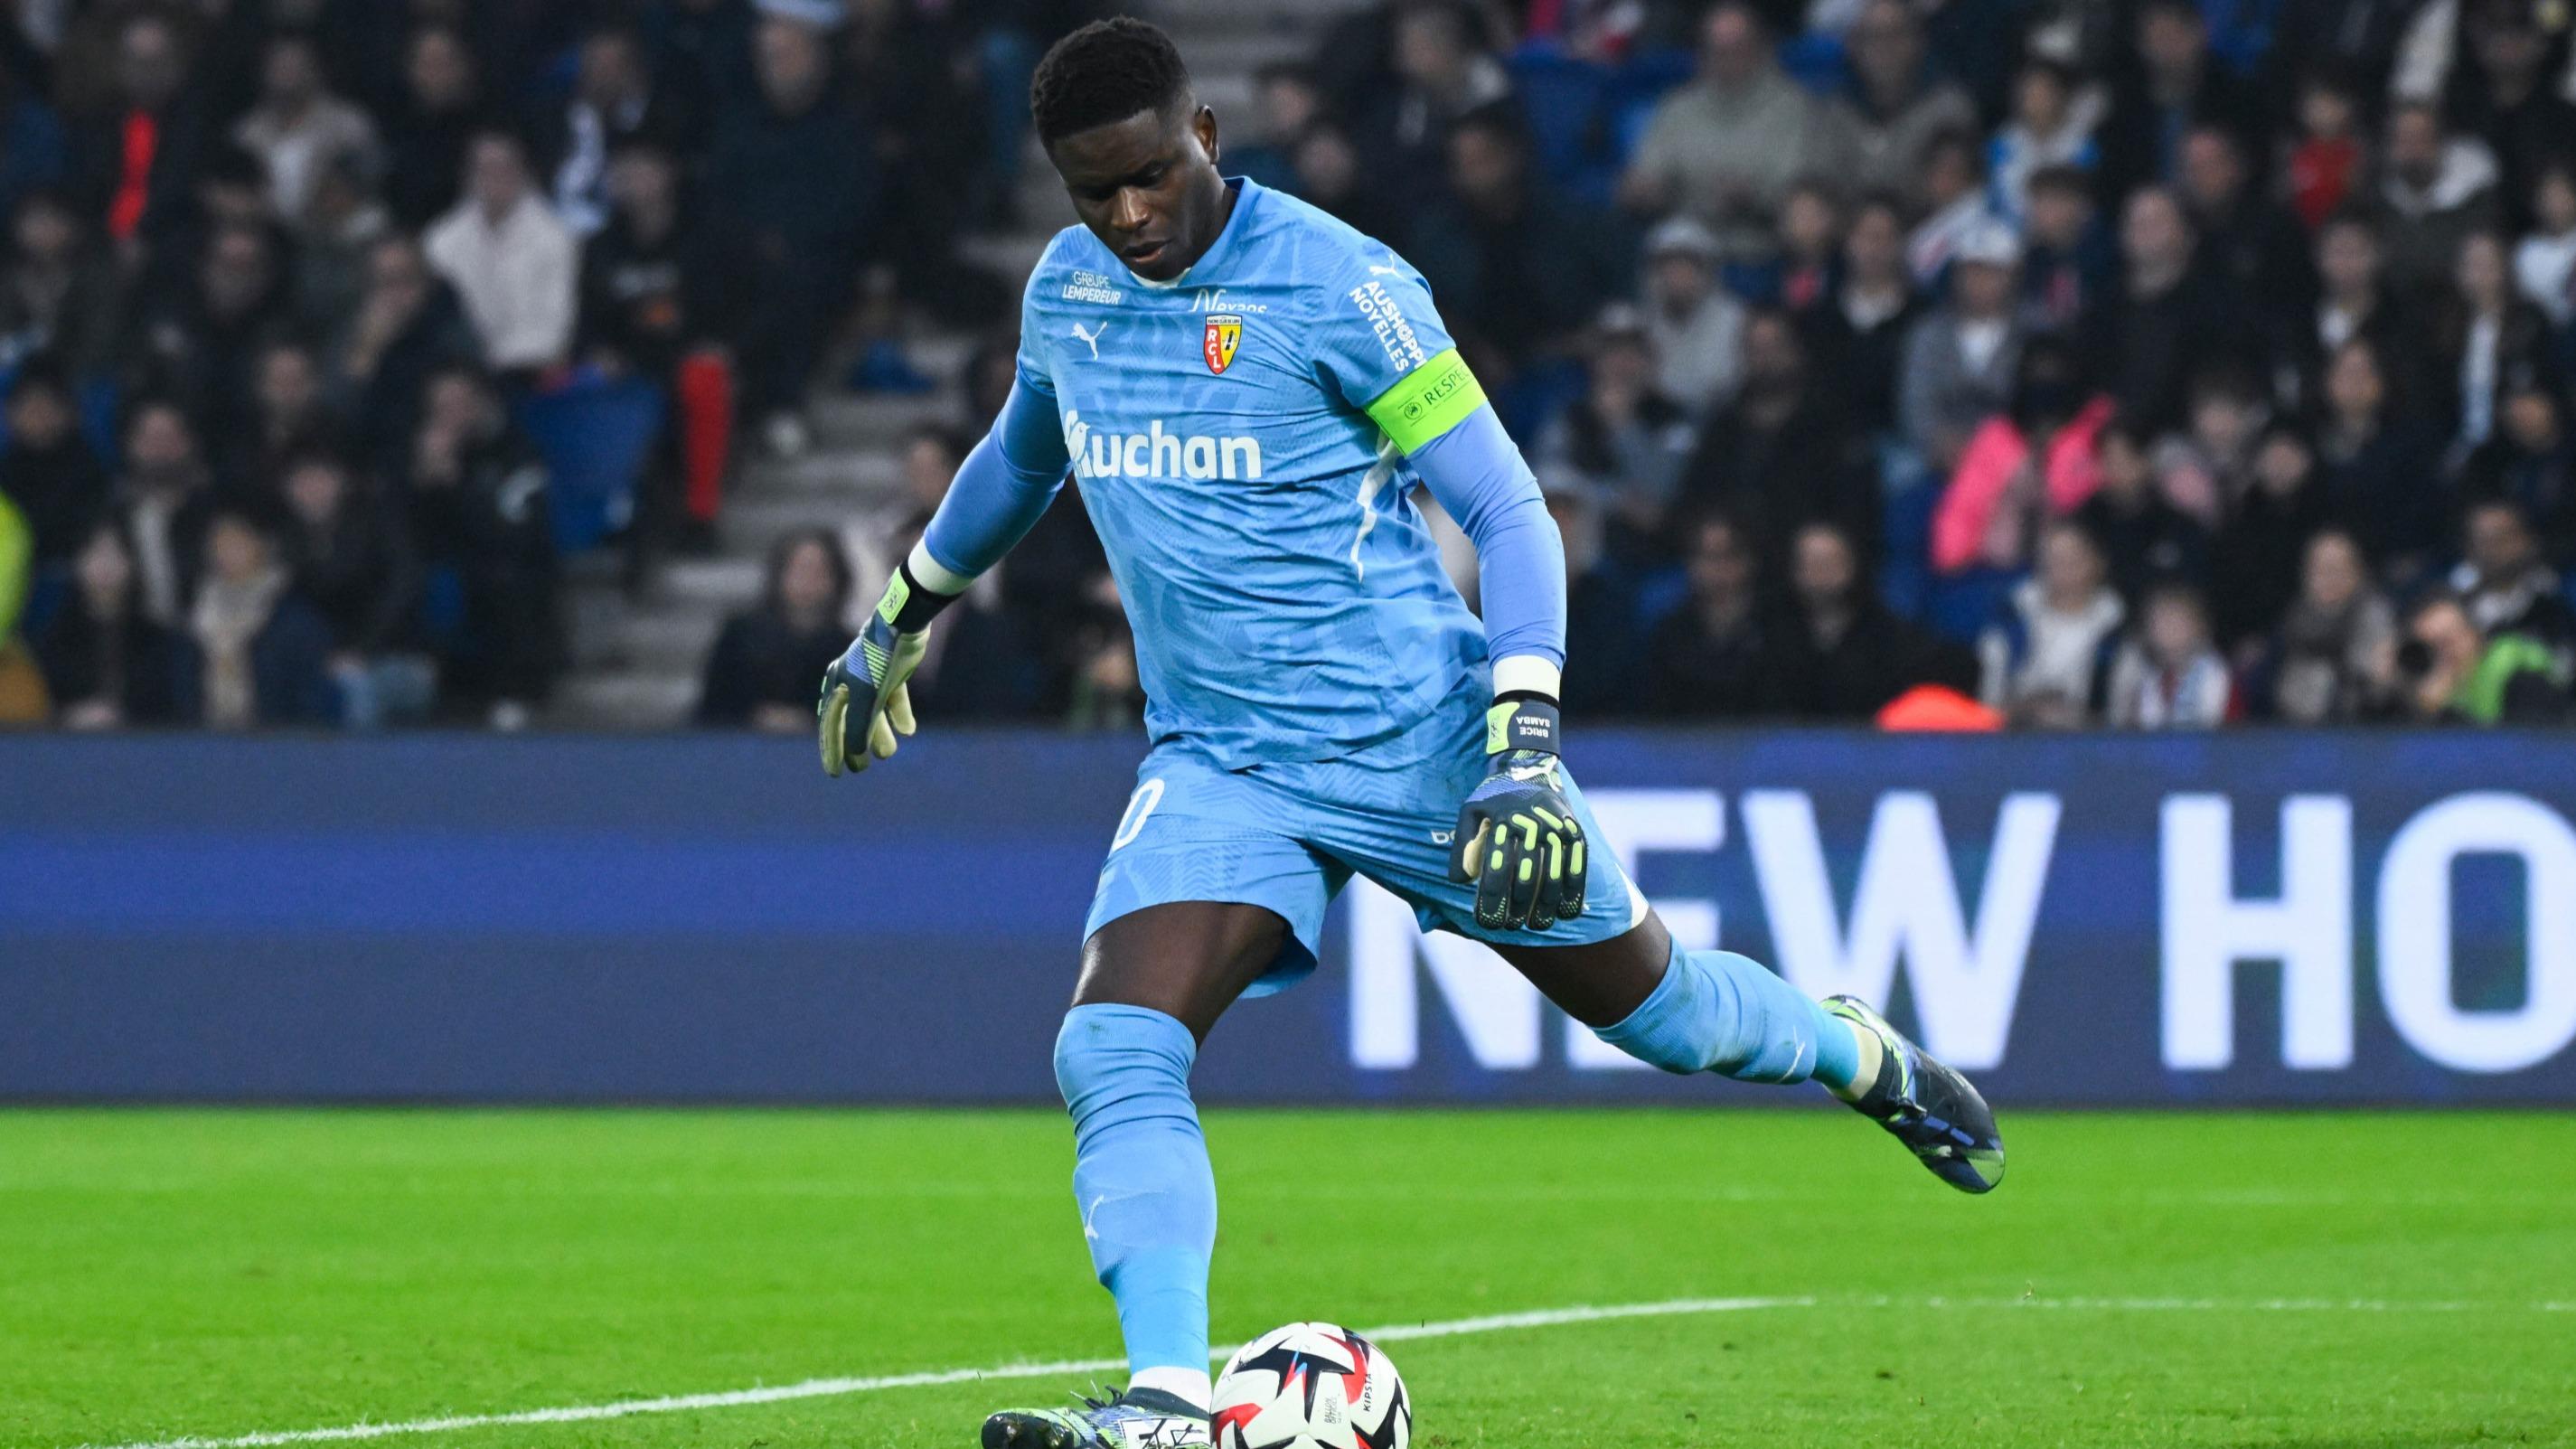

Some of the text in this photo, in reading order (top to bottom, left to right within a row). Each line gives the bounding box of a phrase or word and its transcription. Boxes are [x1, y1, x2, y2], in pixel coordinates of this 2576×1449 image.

[1062, 284, 1122, 305] LEMPEREUR
[1073, 270, 1112, 289] GROUPE
[1349, 287, 1409, 372] NOYELLES
[1065, 409, 1262, 479] Auchan
[1516, 716, 1550, 728] SAMBA
[1519, 726, 1549, 738] BRICE
[2158, 789, 2576, 1073] HO
[1363, 1373, 1373, 1412] KIPSTA
